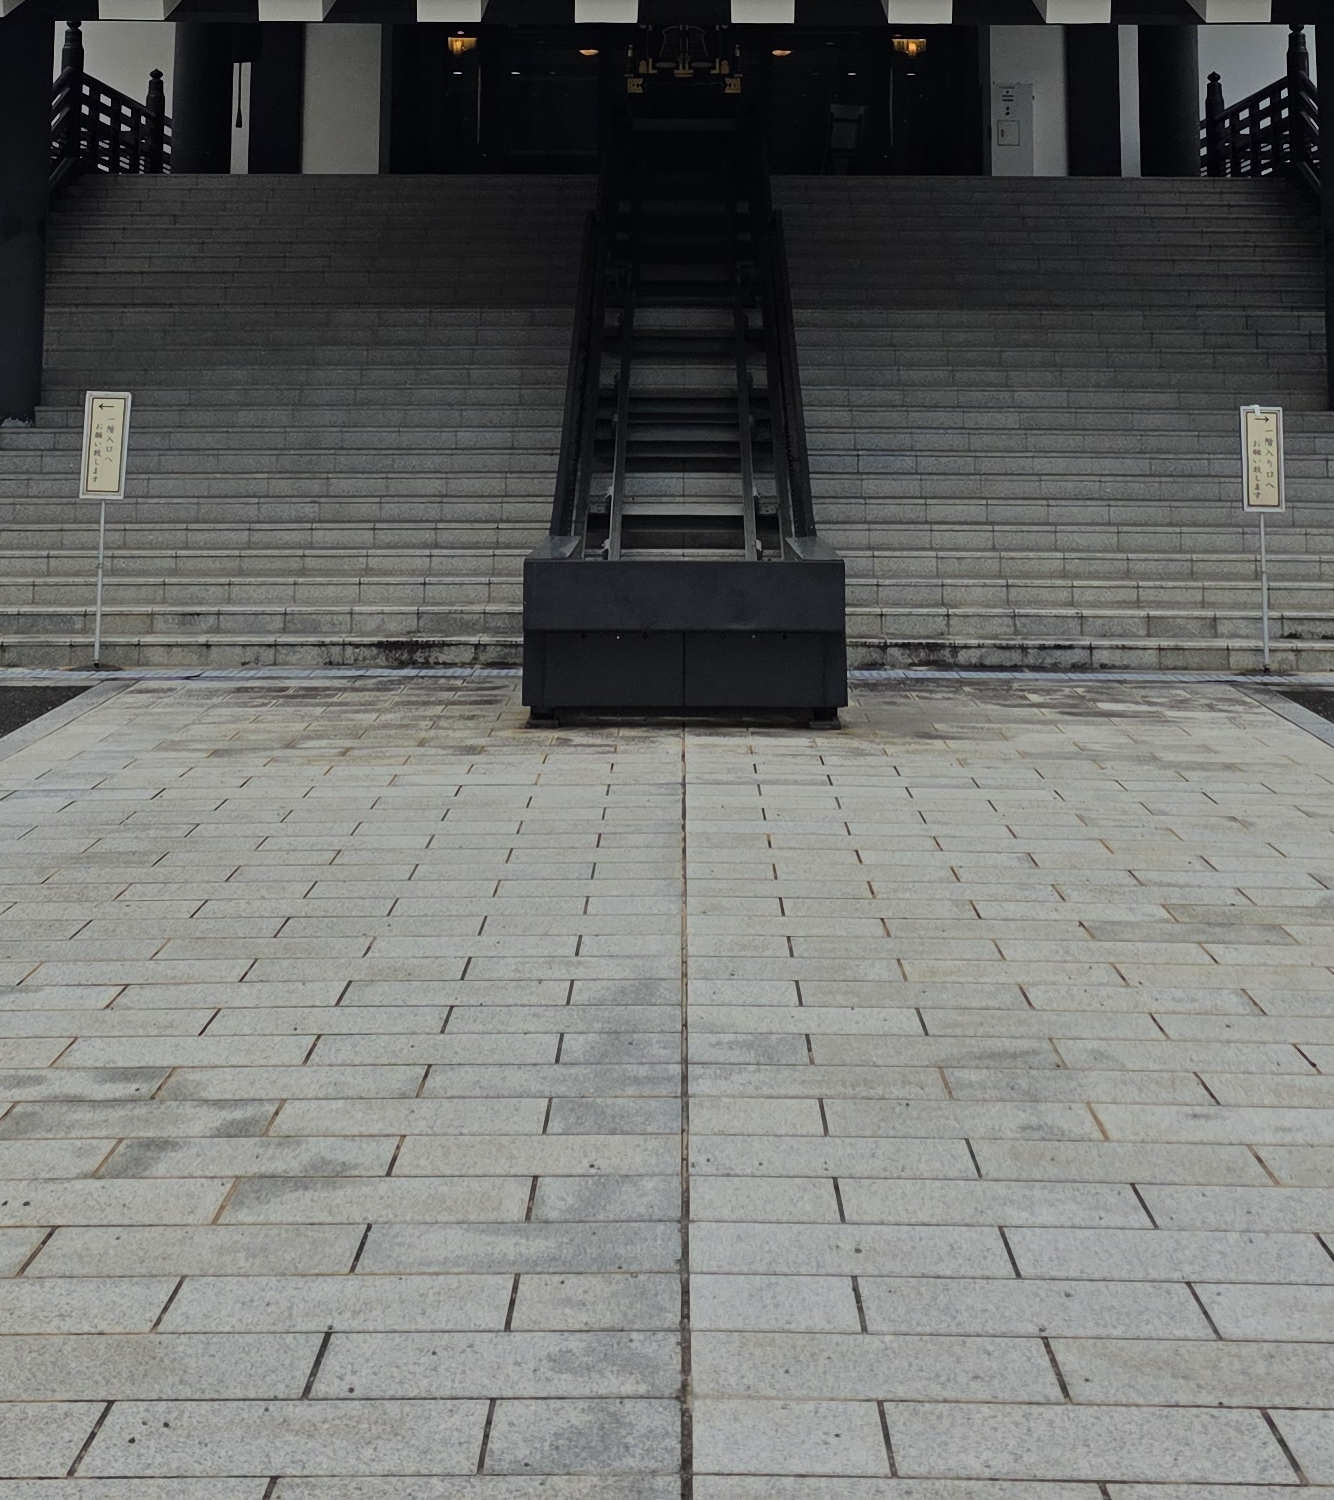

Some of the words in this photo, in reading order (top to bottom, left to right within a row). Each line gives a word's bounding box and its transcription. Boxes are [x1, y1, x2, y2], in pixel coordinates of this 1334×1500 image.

[92, 423, 103, 483] お願い致します
[1252, 440, 1262, 499] お願い致します
